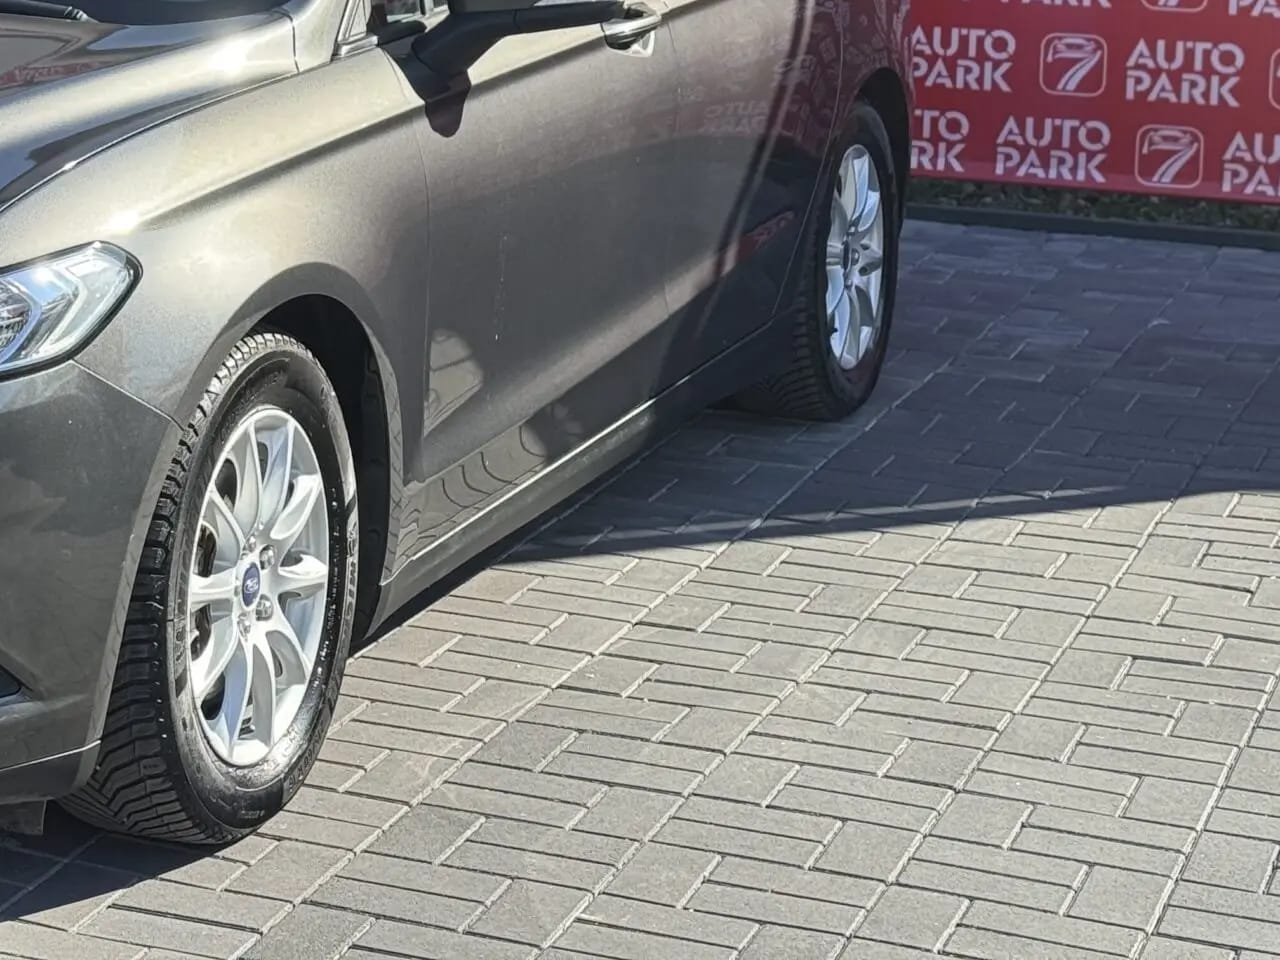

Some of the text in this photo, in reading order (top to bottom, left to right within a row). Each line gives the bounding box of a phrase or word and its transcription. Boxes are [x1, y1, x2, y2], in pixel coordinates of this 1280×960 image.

[911, 26, 1016, 59] AUTO
[1126, 39, 1244, 74] AUTO
[909, 56, 1012, 92] PARK
[1126, 70, 1240, 107] PARK
[997, 116, 1110, 150] AUTO
[995, 147, 1106, 183] PARK
